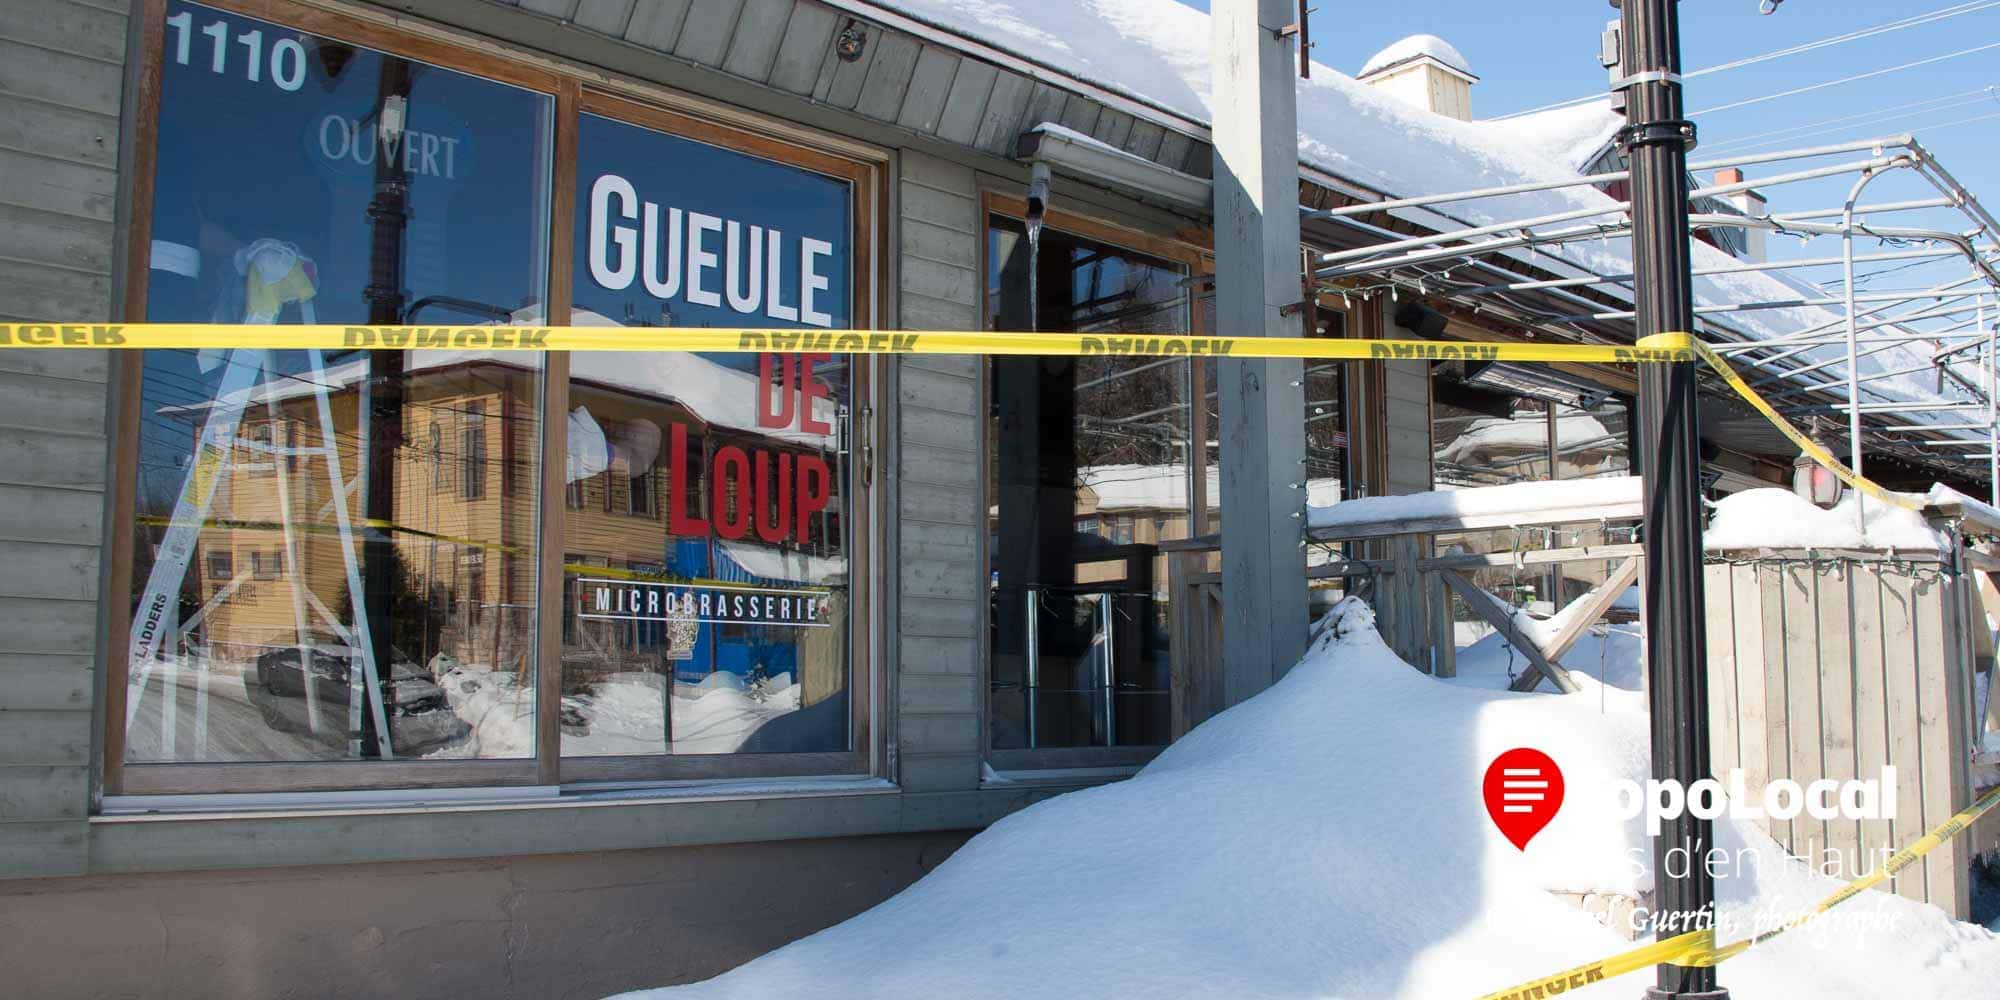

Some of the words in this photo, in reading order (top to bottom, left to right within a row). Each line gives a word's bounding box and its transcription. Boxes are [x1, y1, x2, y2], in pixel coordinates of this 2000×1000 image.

[167, 11, 307, 92] 1110
[319, 114, 460, 180] OUVERT
[668, 422, 831, 545] LOUP
[134, 592, 168, 659] LADDERS
[595, 587, 817, 621] MICROBRASSERIE
